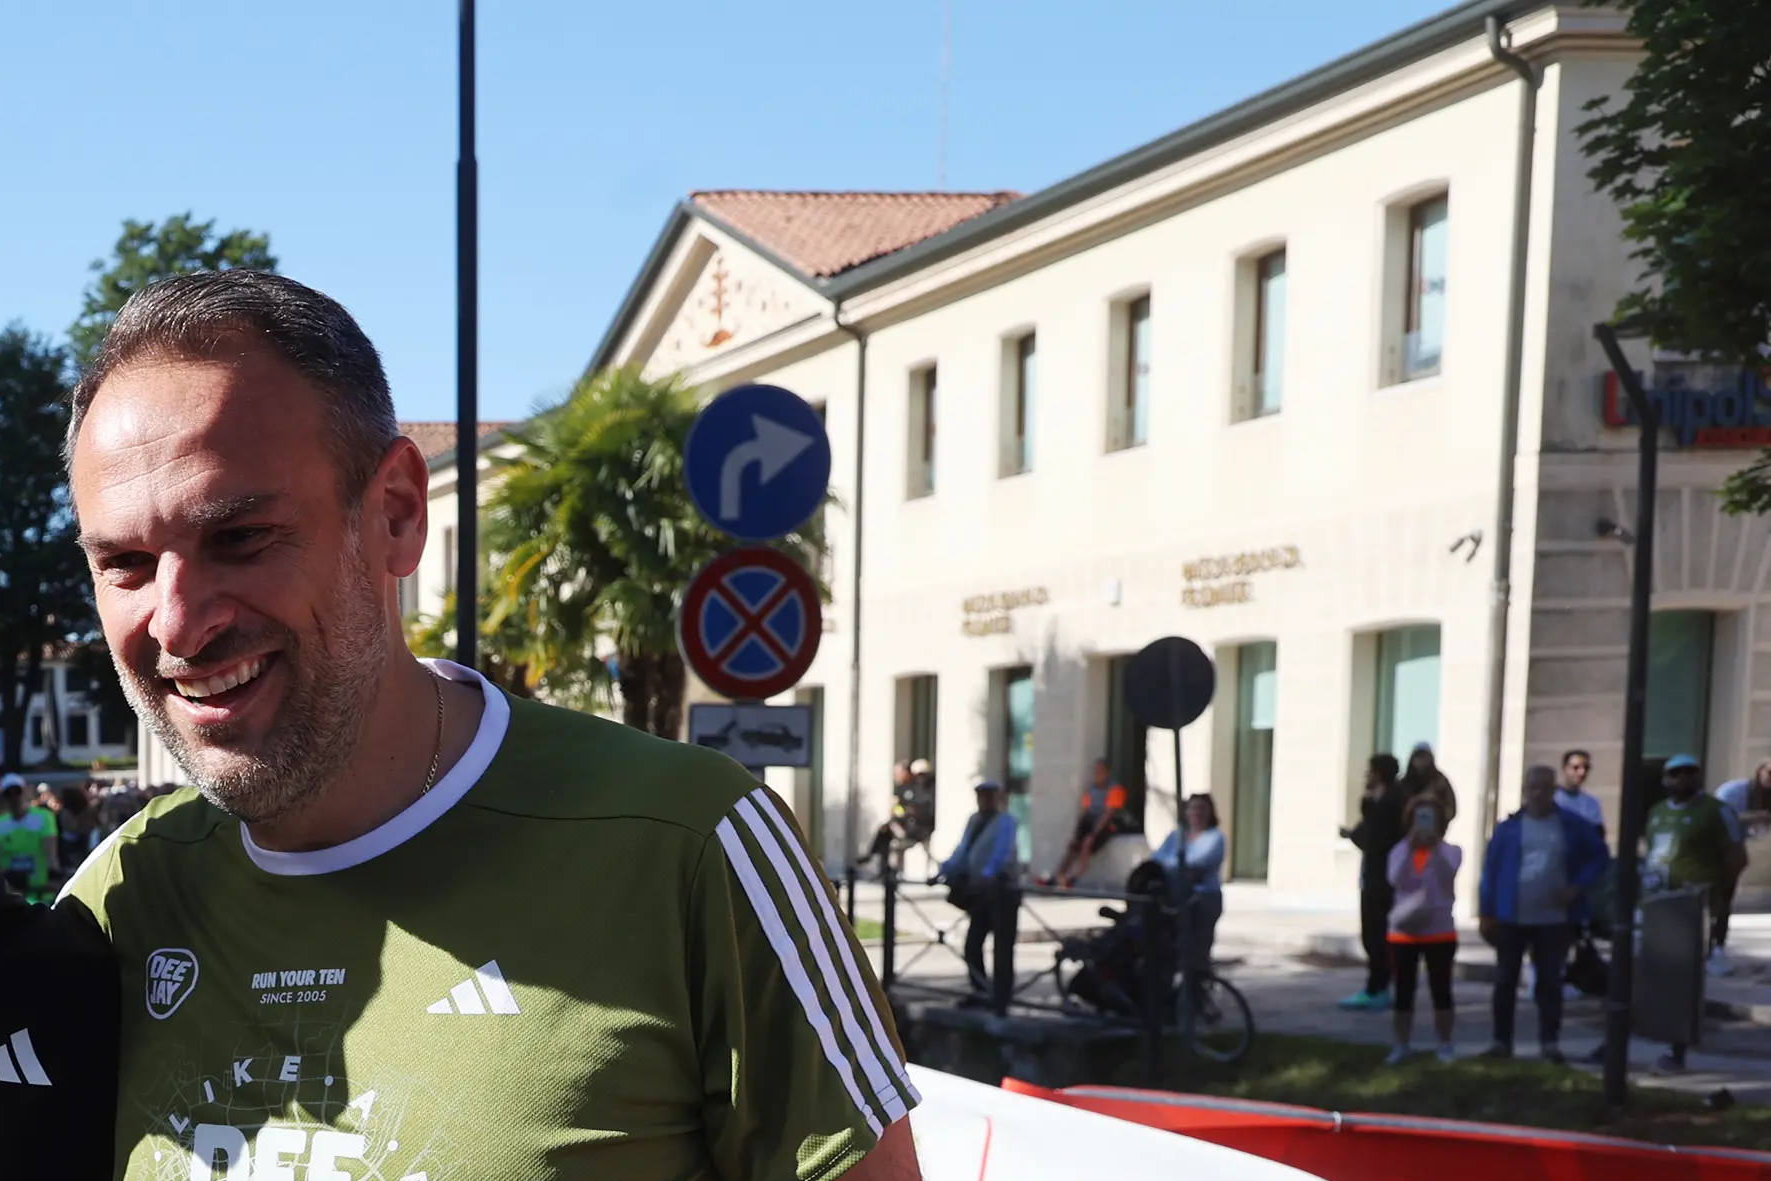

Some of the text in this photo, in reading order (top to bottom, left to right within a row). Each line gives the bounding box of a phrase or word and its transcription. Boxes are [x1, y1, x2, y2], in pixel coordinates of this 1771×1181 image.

[149, 955, 193, 980] DEE
[251, 968, 346, 989] RUN YOUR TEN
[149, 977, 182, 1006] JAY
[259, 990, 327, 1004] SINCE 2005
